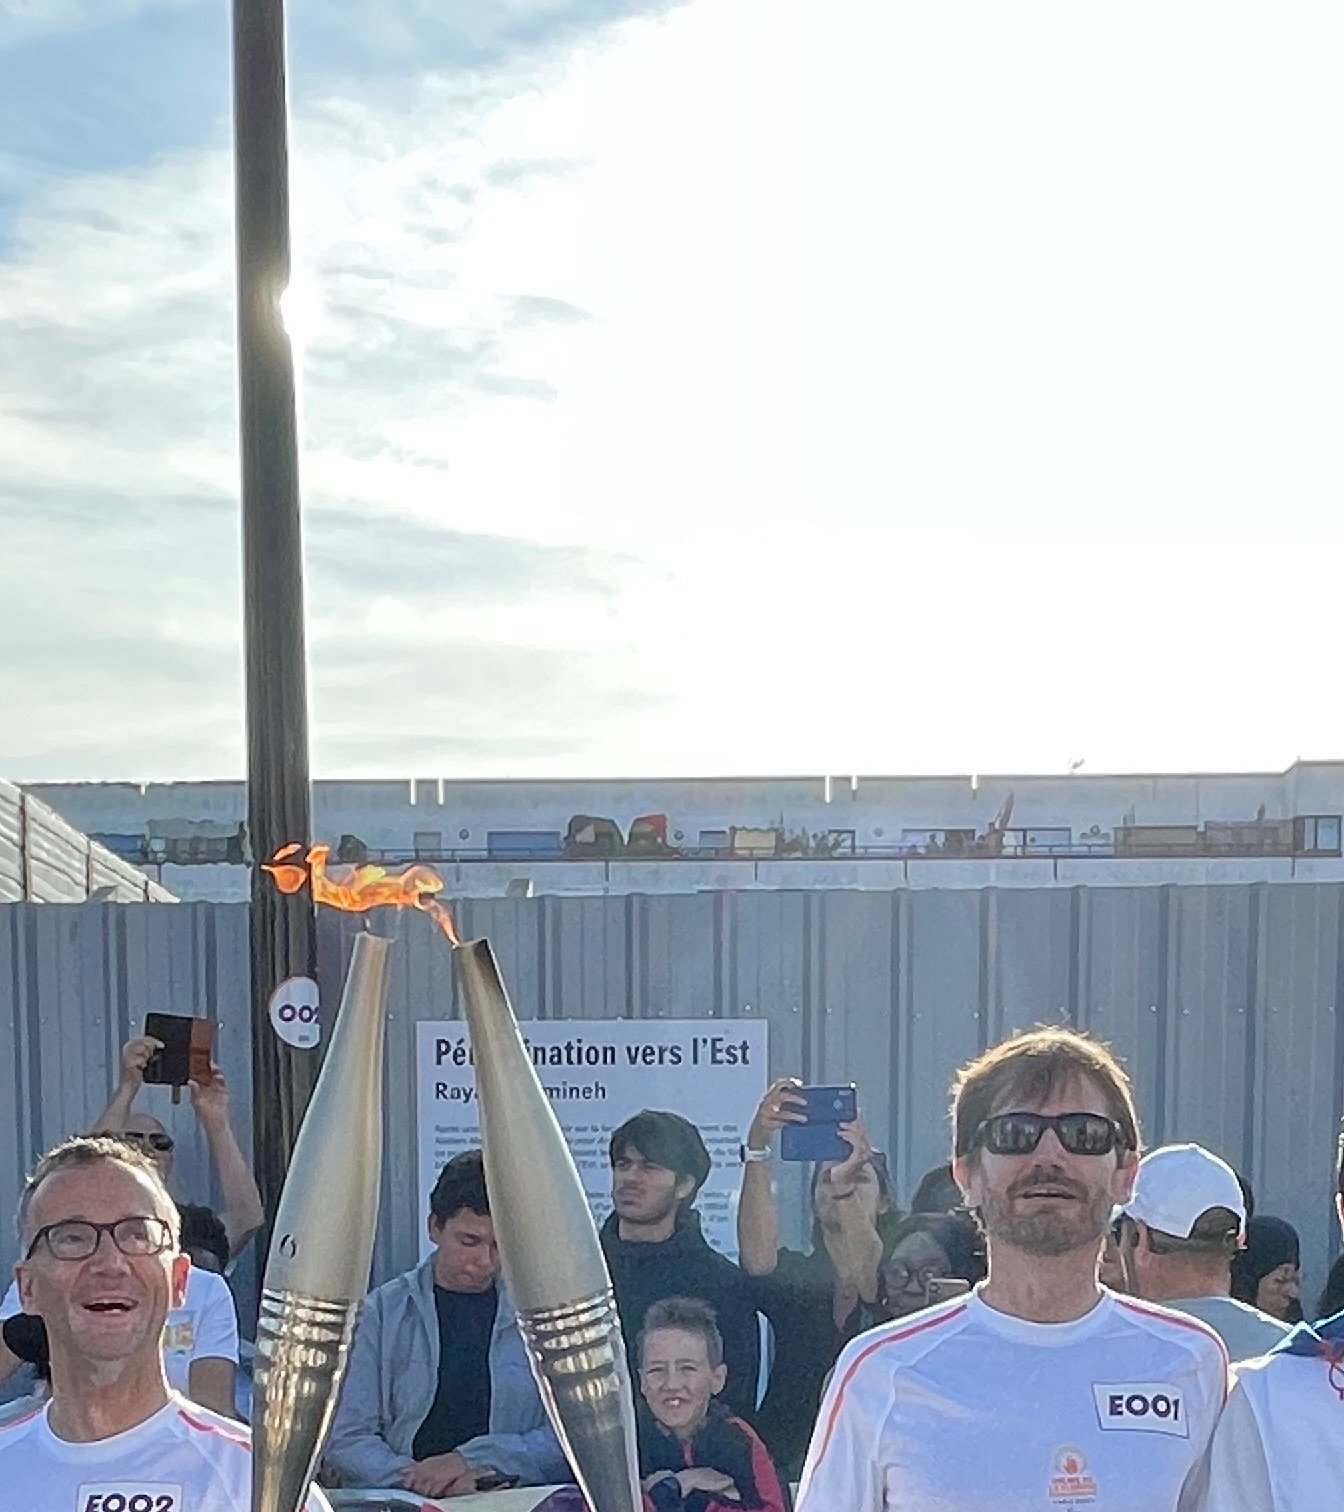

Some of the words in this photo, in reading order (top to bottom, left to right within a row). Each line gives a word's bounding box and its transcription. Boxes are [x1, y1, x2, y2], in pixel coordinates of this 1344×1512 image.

[626, 1045, 682, 1066] vers
[435, 1082, 479, 1105] Ray
[542, 1080, 607, 1101] mineh
